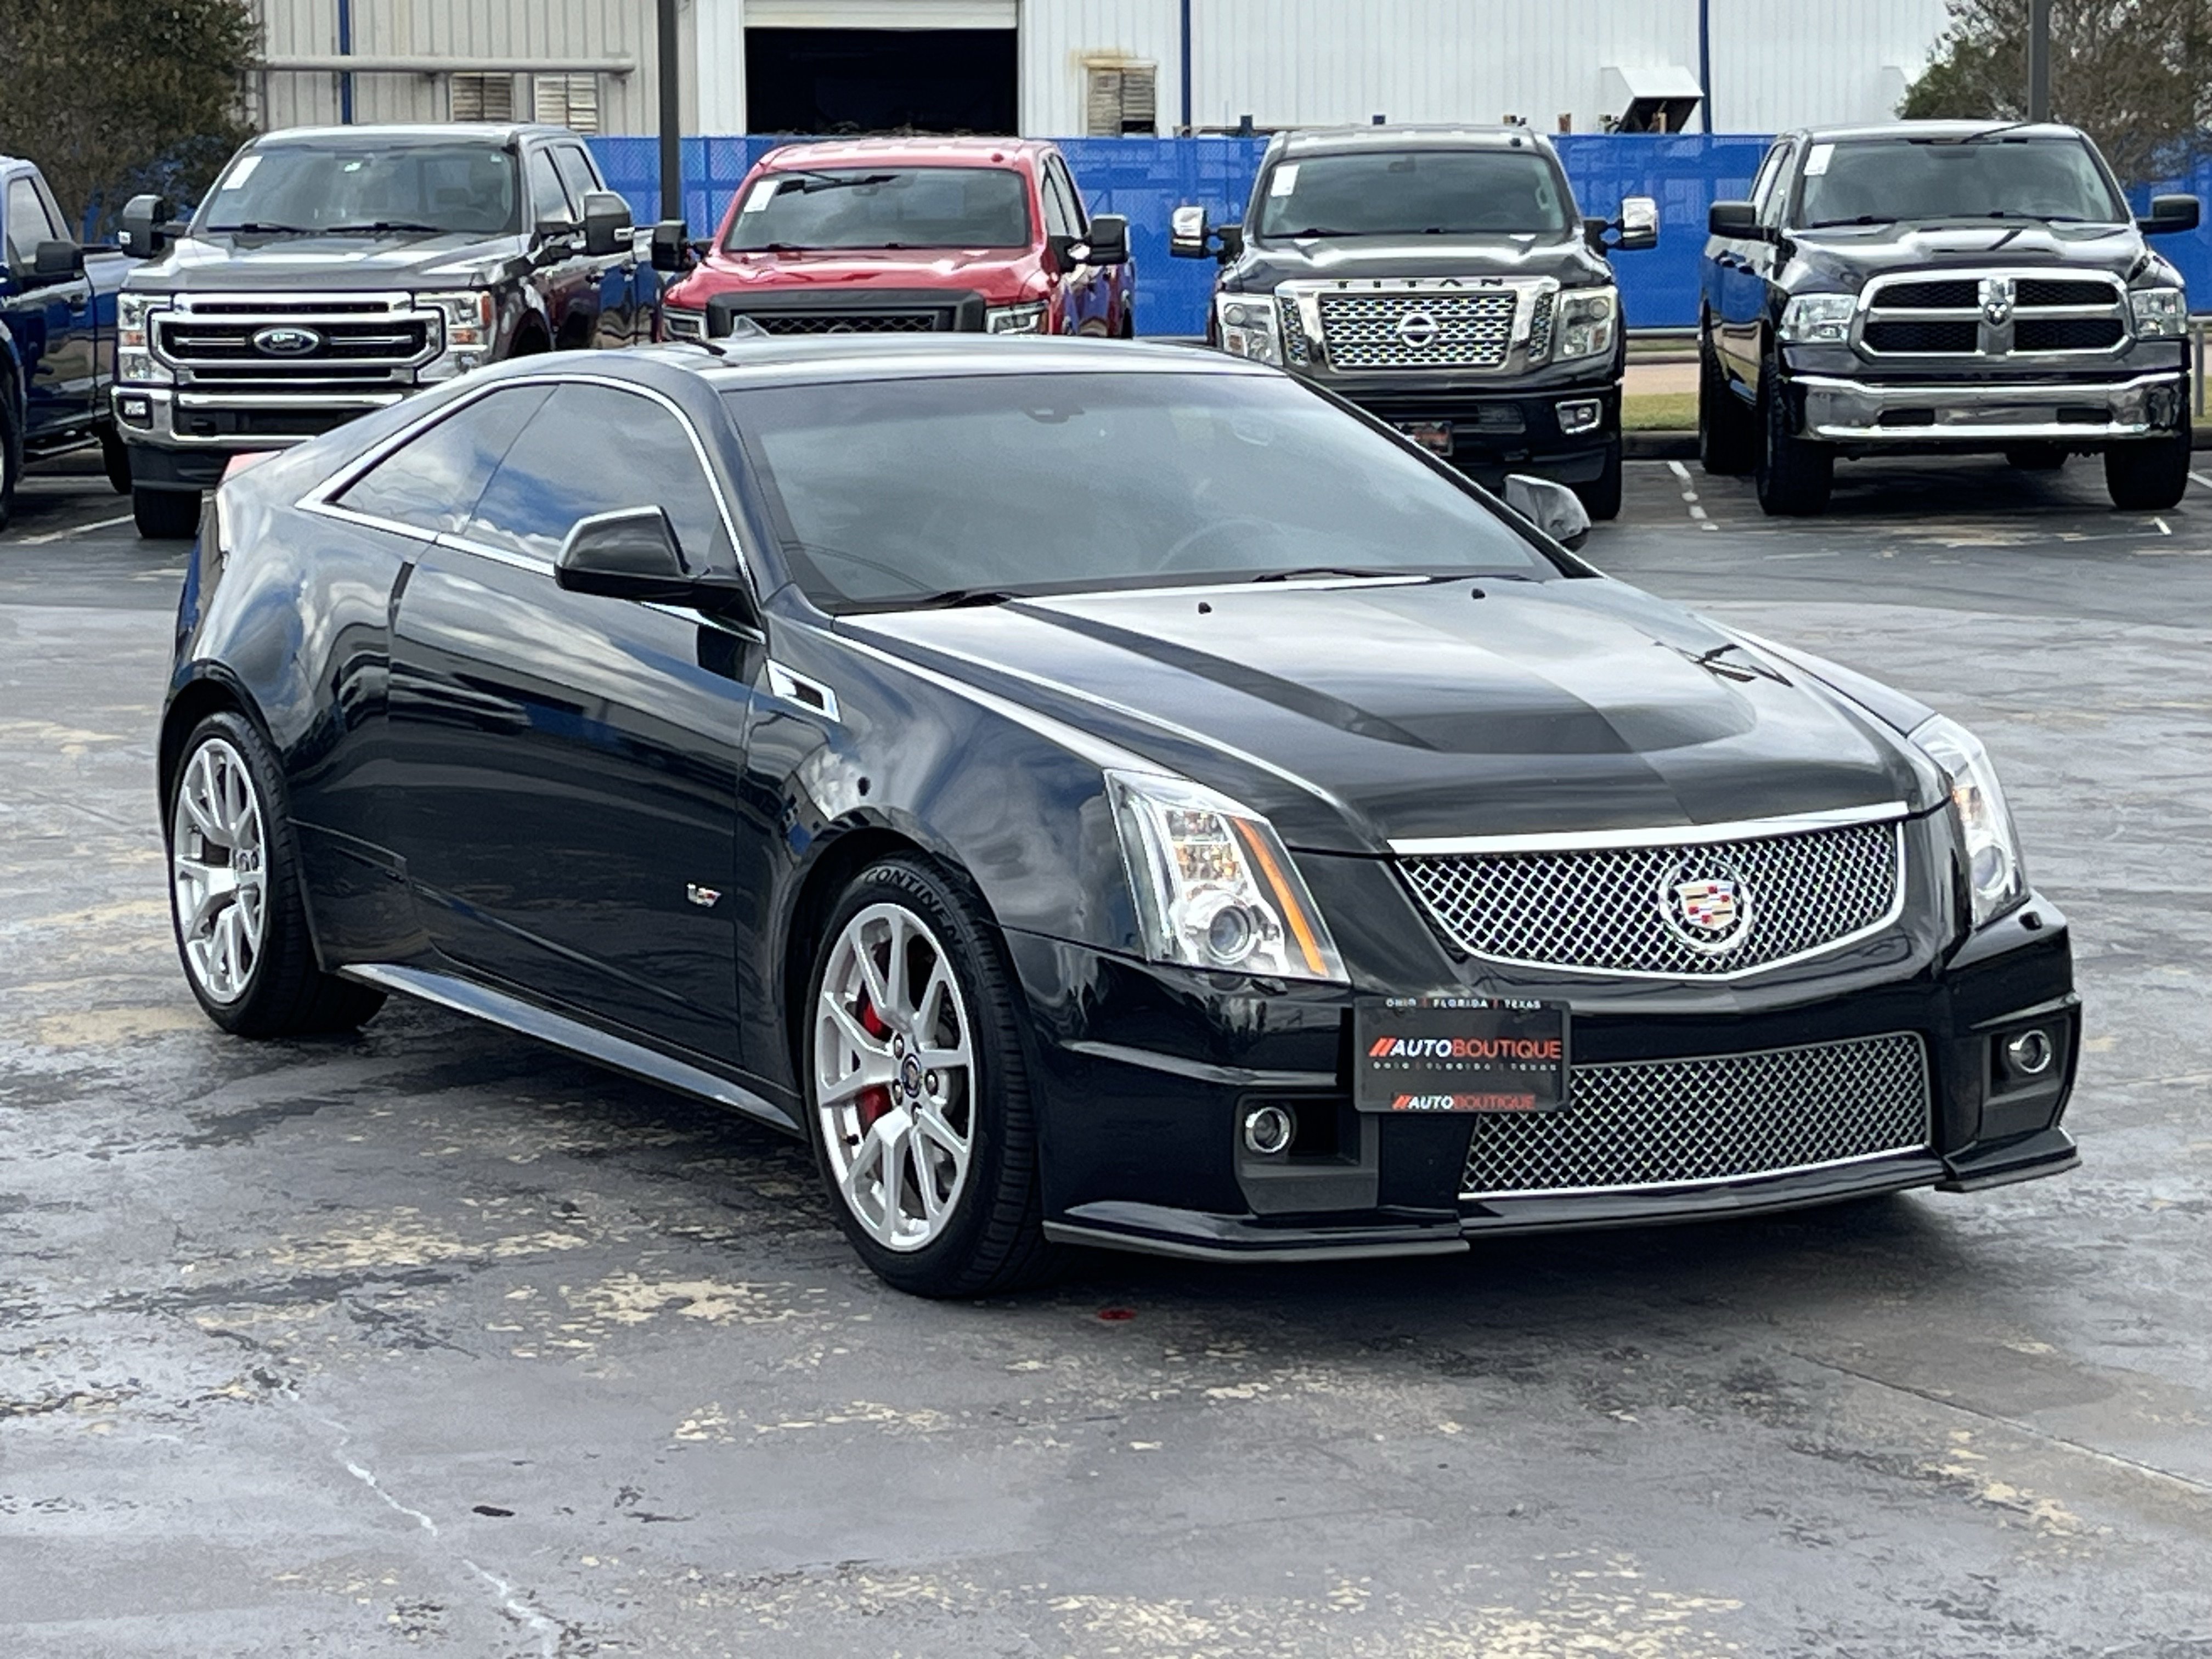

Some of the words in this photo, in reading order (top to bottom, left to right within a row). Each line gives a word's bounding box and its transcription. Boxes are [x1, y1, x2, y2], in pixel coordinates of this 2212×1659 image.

[1329, 278, 1503, 289] TITAN
[1385, 997, 1417, 1007] OHIO
[1433, 997, 1488, 1008] FLORIDA
[1504, 998, 1541, 1009] TEXAS
